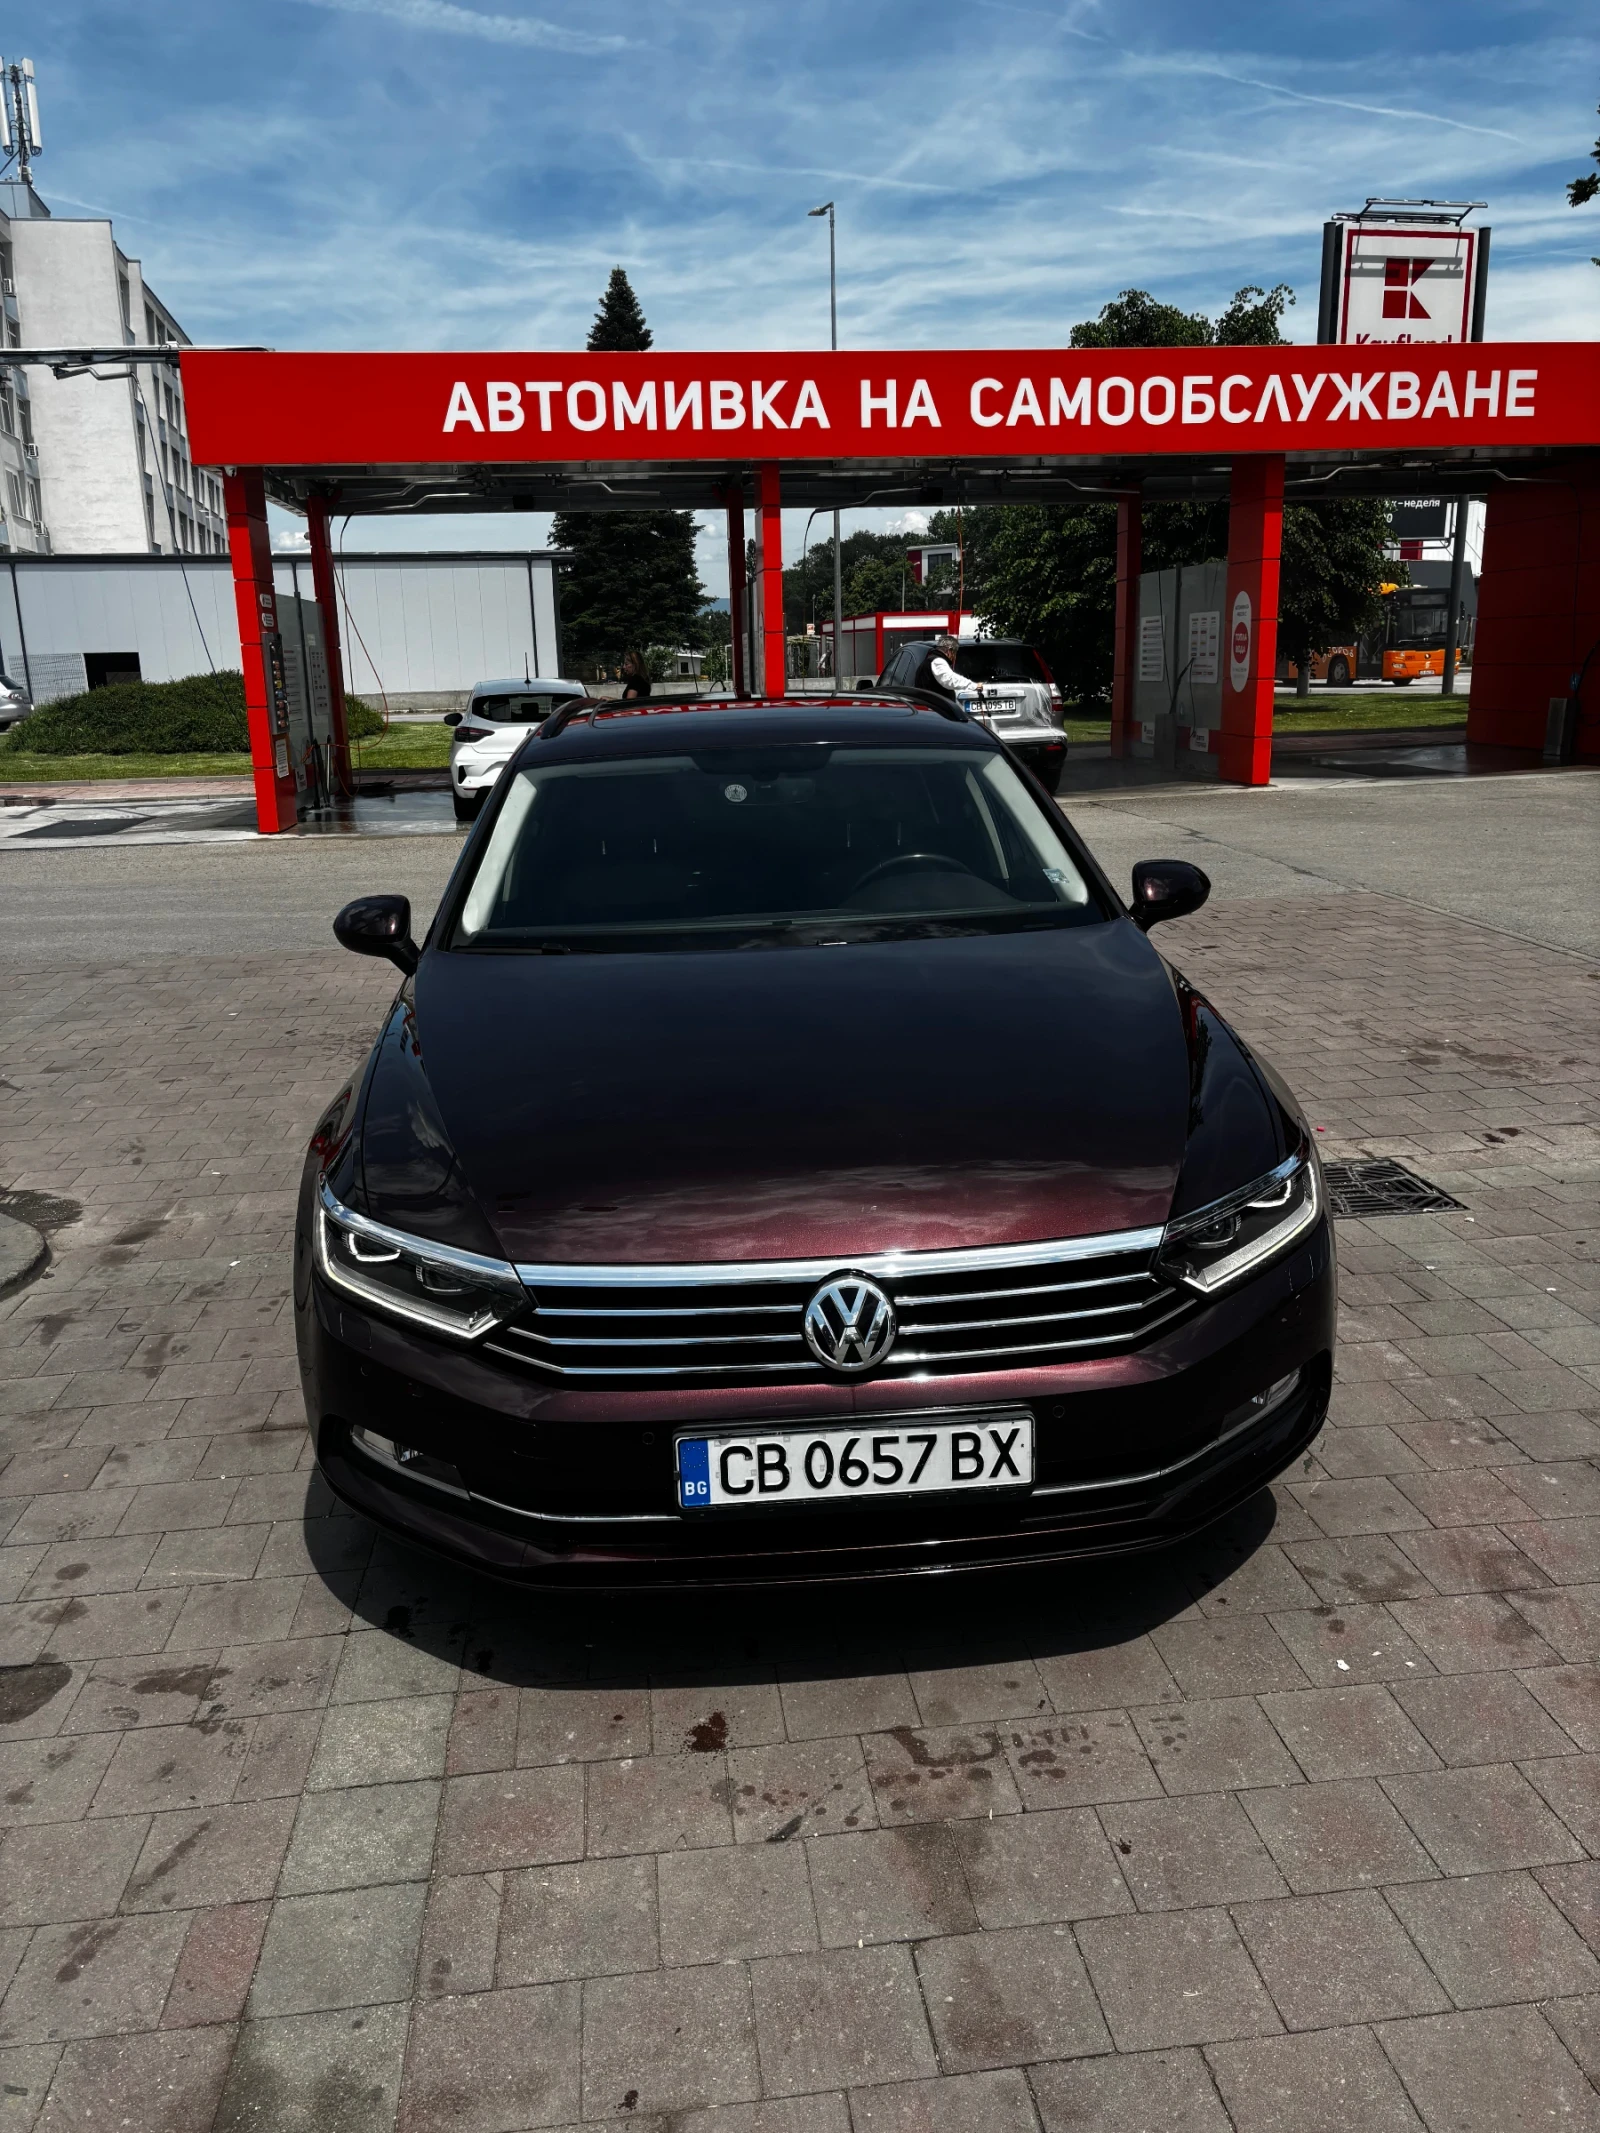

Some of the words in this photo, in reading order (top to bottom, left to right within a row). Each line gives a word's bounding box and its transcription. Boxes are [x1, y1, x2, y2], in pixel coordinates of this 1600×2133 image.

[442, 380, 831, 433] АВТОМИВКА
[860, 378, 942, 429] НА
[970, 369, 1538, 428] САМООБСЛУЖВАНЕ
[684, 1480, 708, 1497] BG
[805, 1433, 938, 1490] 0657
